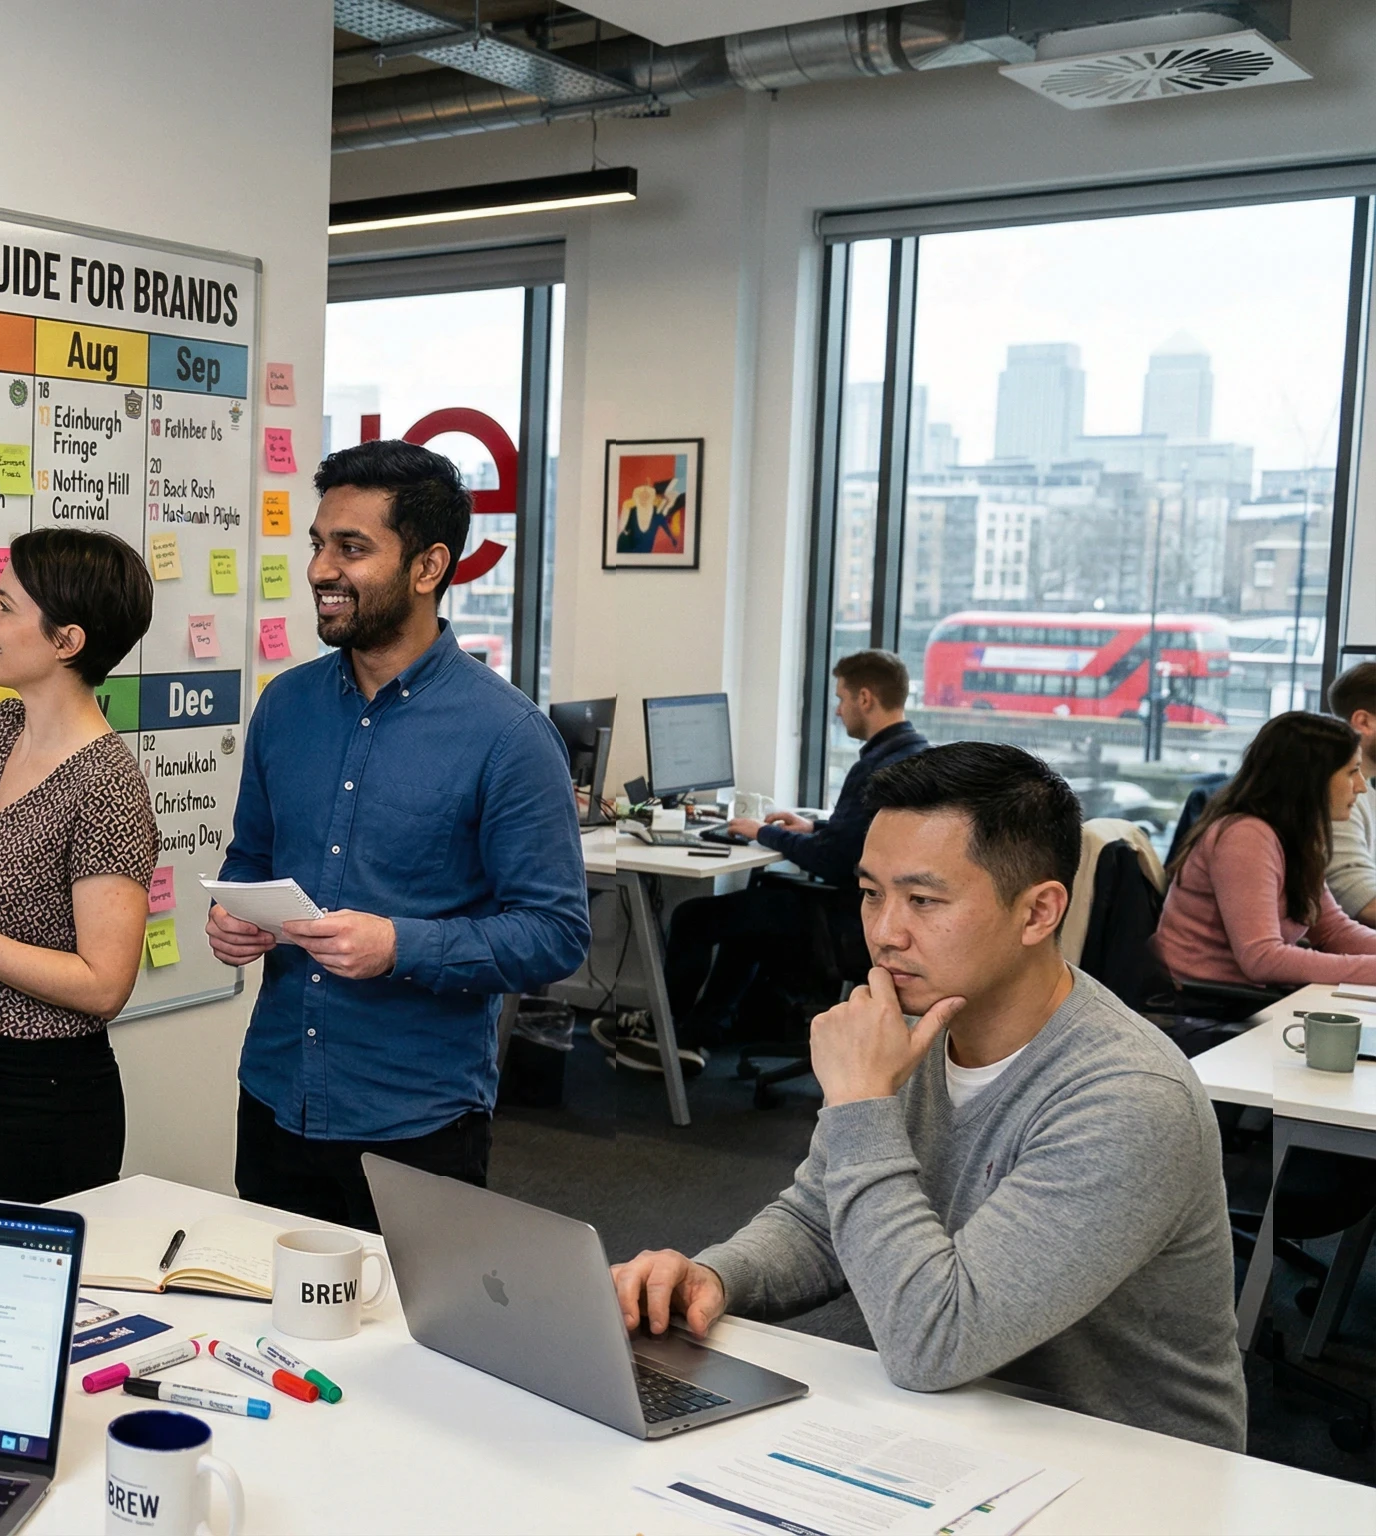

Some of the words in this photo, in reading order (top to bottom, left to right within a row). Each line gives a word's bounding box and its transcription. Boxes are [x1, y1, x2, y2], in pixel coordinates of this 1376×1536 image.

[70, 257, 125, 311] FOR
[133, 268, 239, 327] BRANDS
[68, 331, 119, 381] Aug
[176, 346, 222, 392] Sep
[54, 405, 122, 439] Edinburgh
[54, 431, 97, 463] Fringe
[149, 457, 162, 474] 20
[53, 469, 103, 501] Notting
[108, 472, 130, 495] Hill
[52, 496, 109, 520] Carnival
[169, 682, 214, 718] Dec
[155, 750, 217, 777] Hanukkah
[155, 789, 217, 815] Christmas
[199, 823, 223, 851] Day
[301, 1279, 358, 1305] BREW
[108, 1480, 160, 1519] BREW
